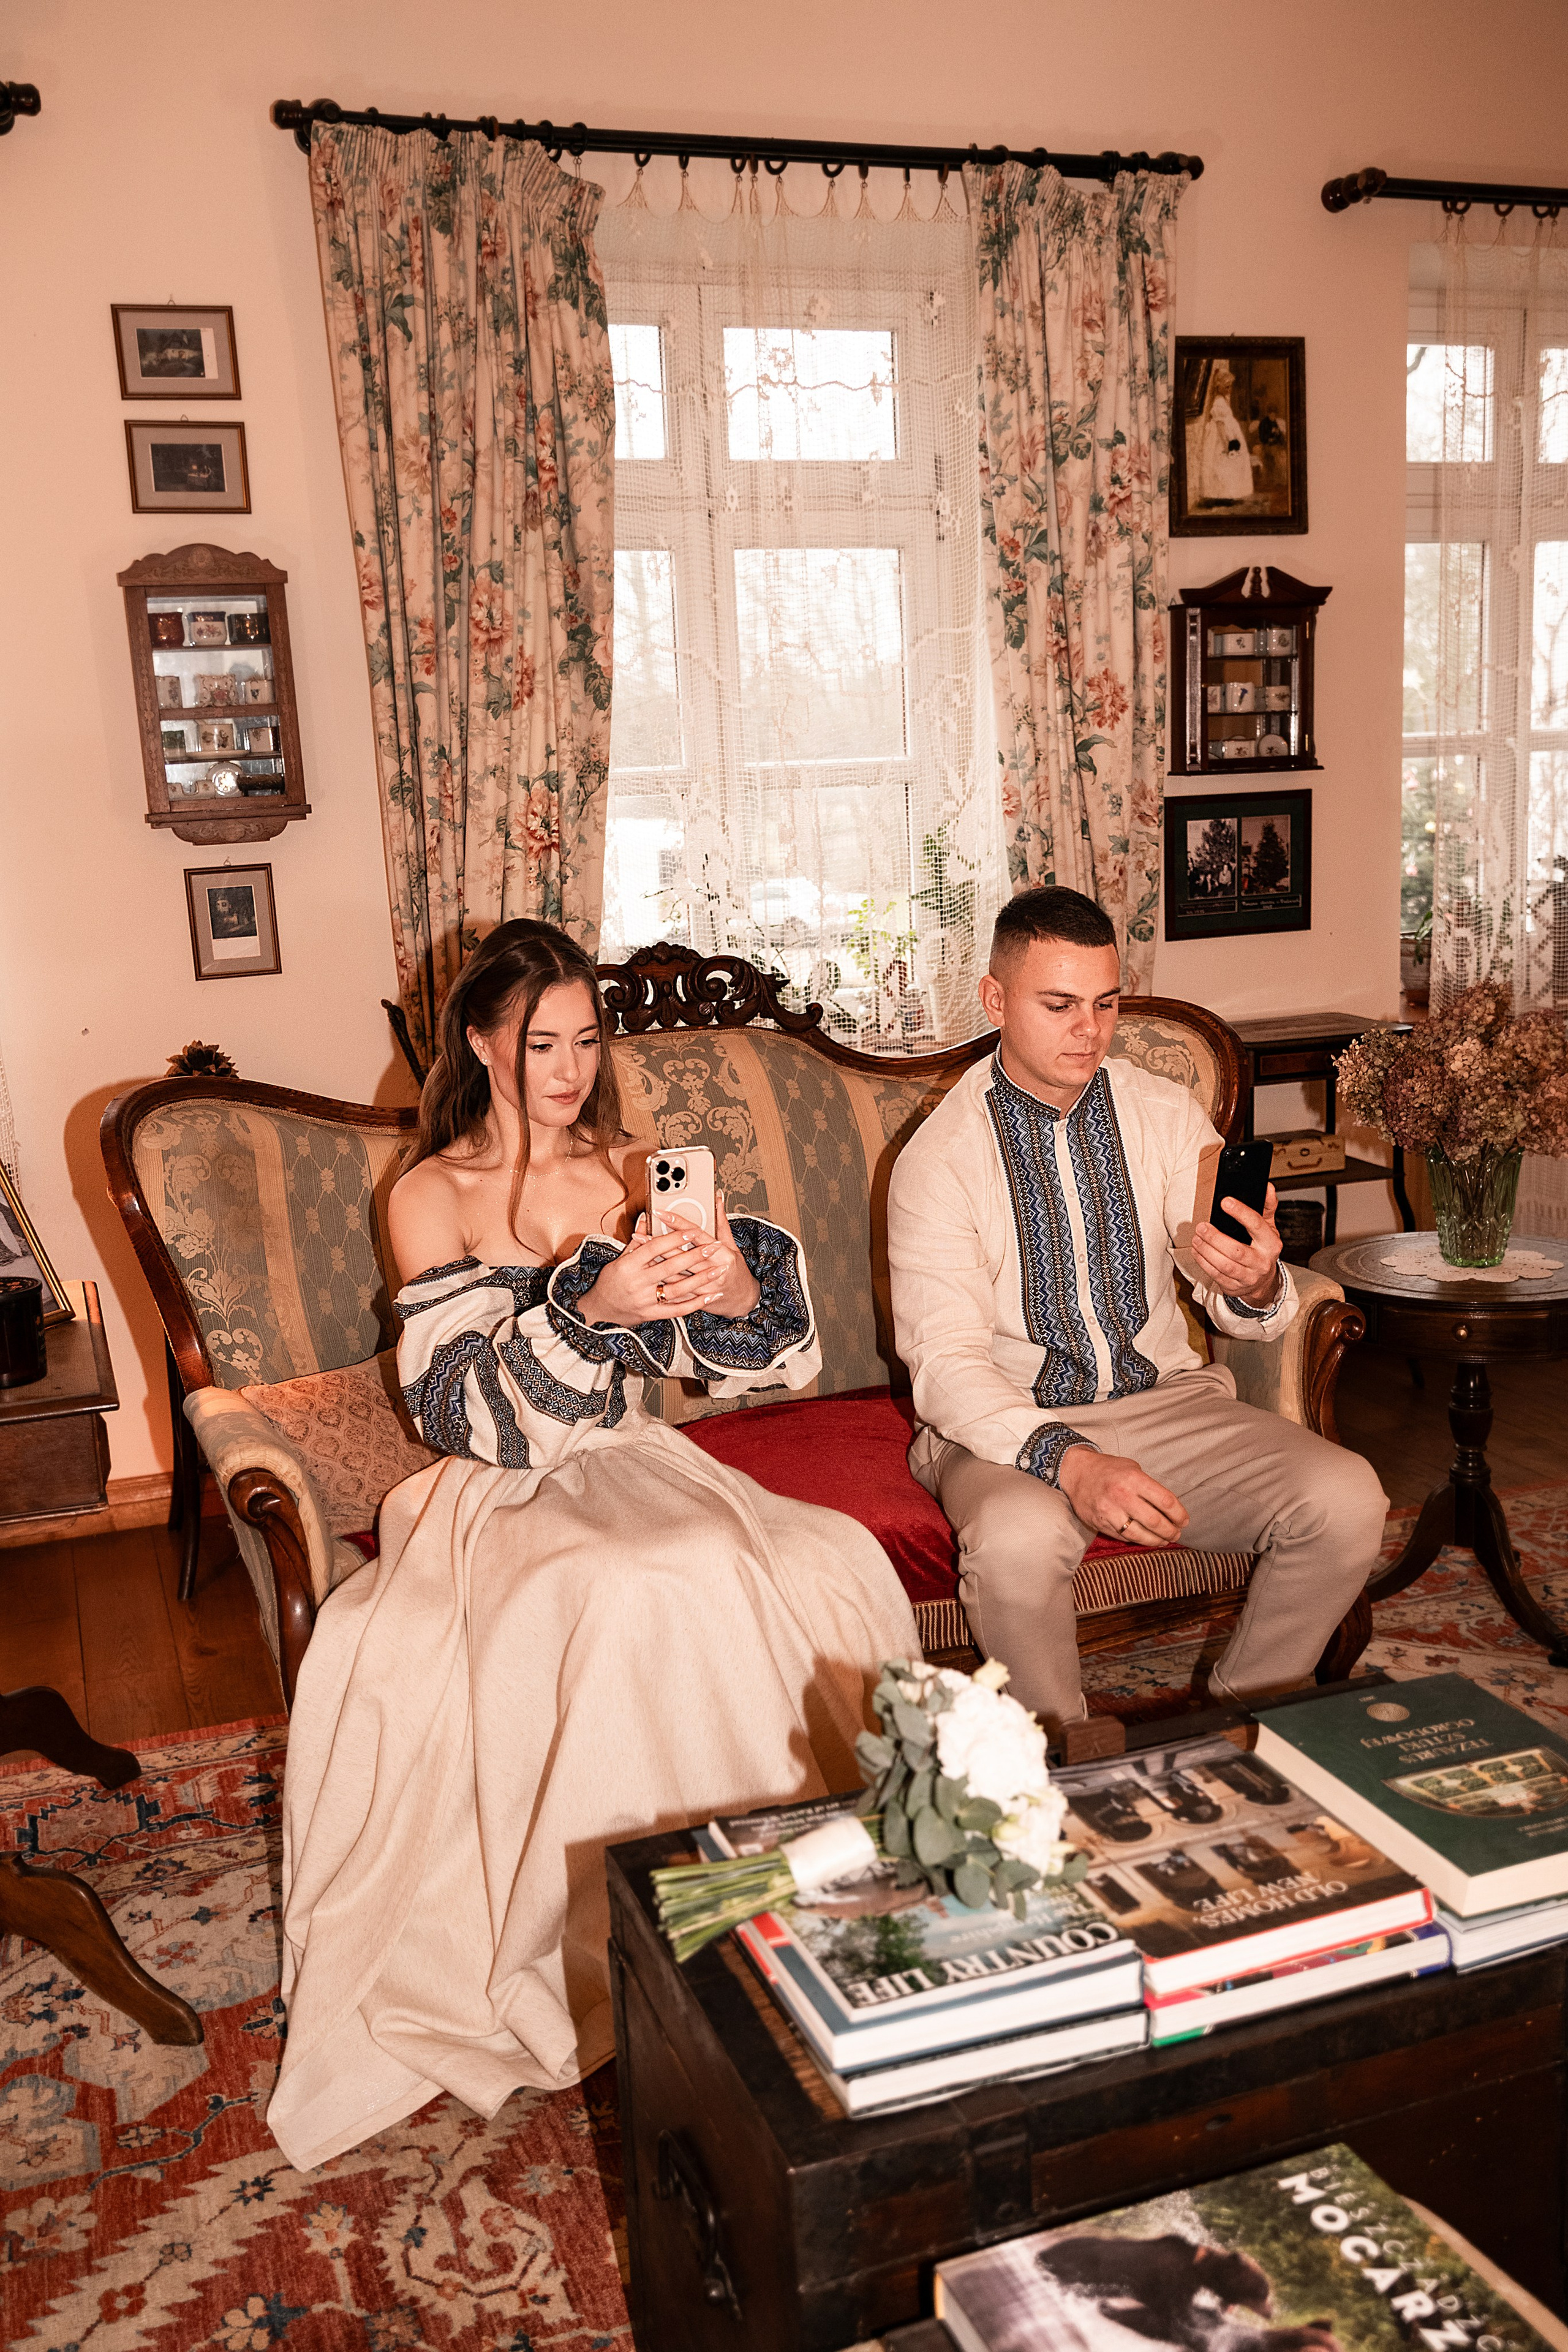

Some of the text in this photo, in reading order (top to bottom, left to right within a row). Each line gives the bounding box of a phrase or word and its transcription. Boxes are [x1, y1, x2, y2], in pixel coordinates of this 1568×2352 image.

[1360, 1719, 1475, 1749] OGRODOWEJ
[1399, 1732, 1466, 1751] SZTUKI
[1399, 1738, 1493, 1763] TEZAURUS
[1193, 1871, 1321, 1912] NEW LIFE
[1193, 1880, 1348, 1929] OLD HOMES,
[846, 1922, 1120, 2005] COUNTRY LIFE
[1278, 2173, 1471, 2352] MOCARZ
